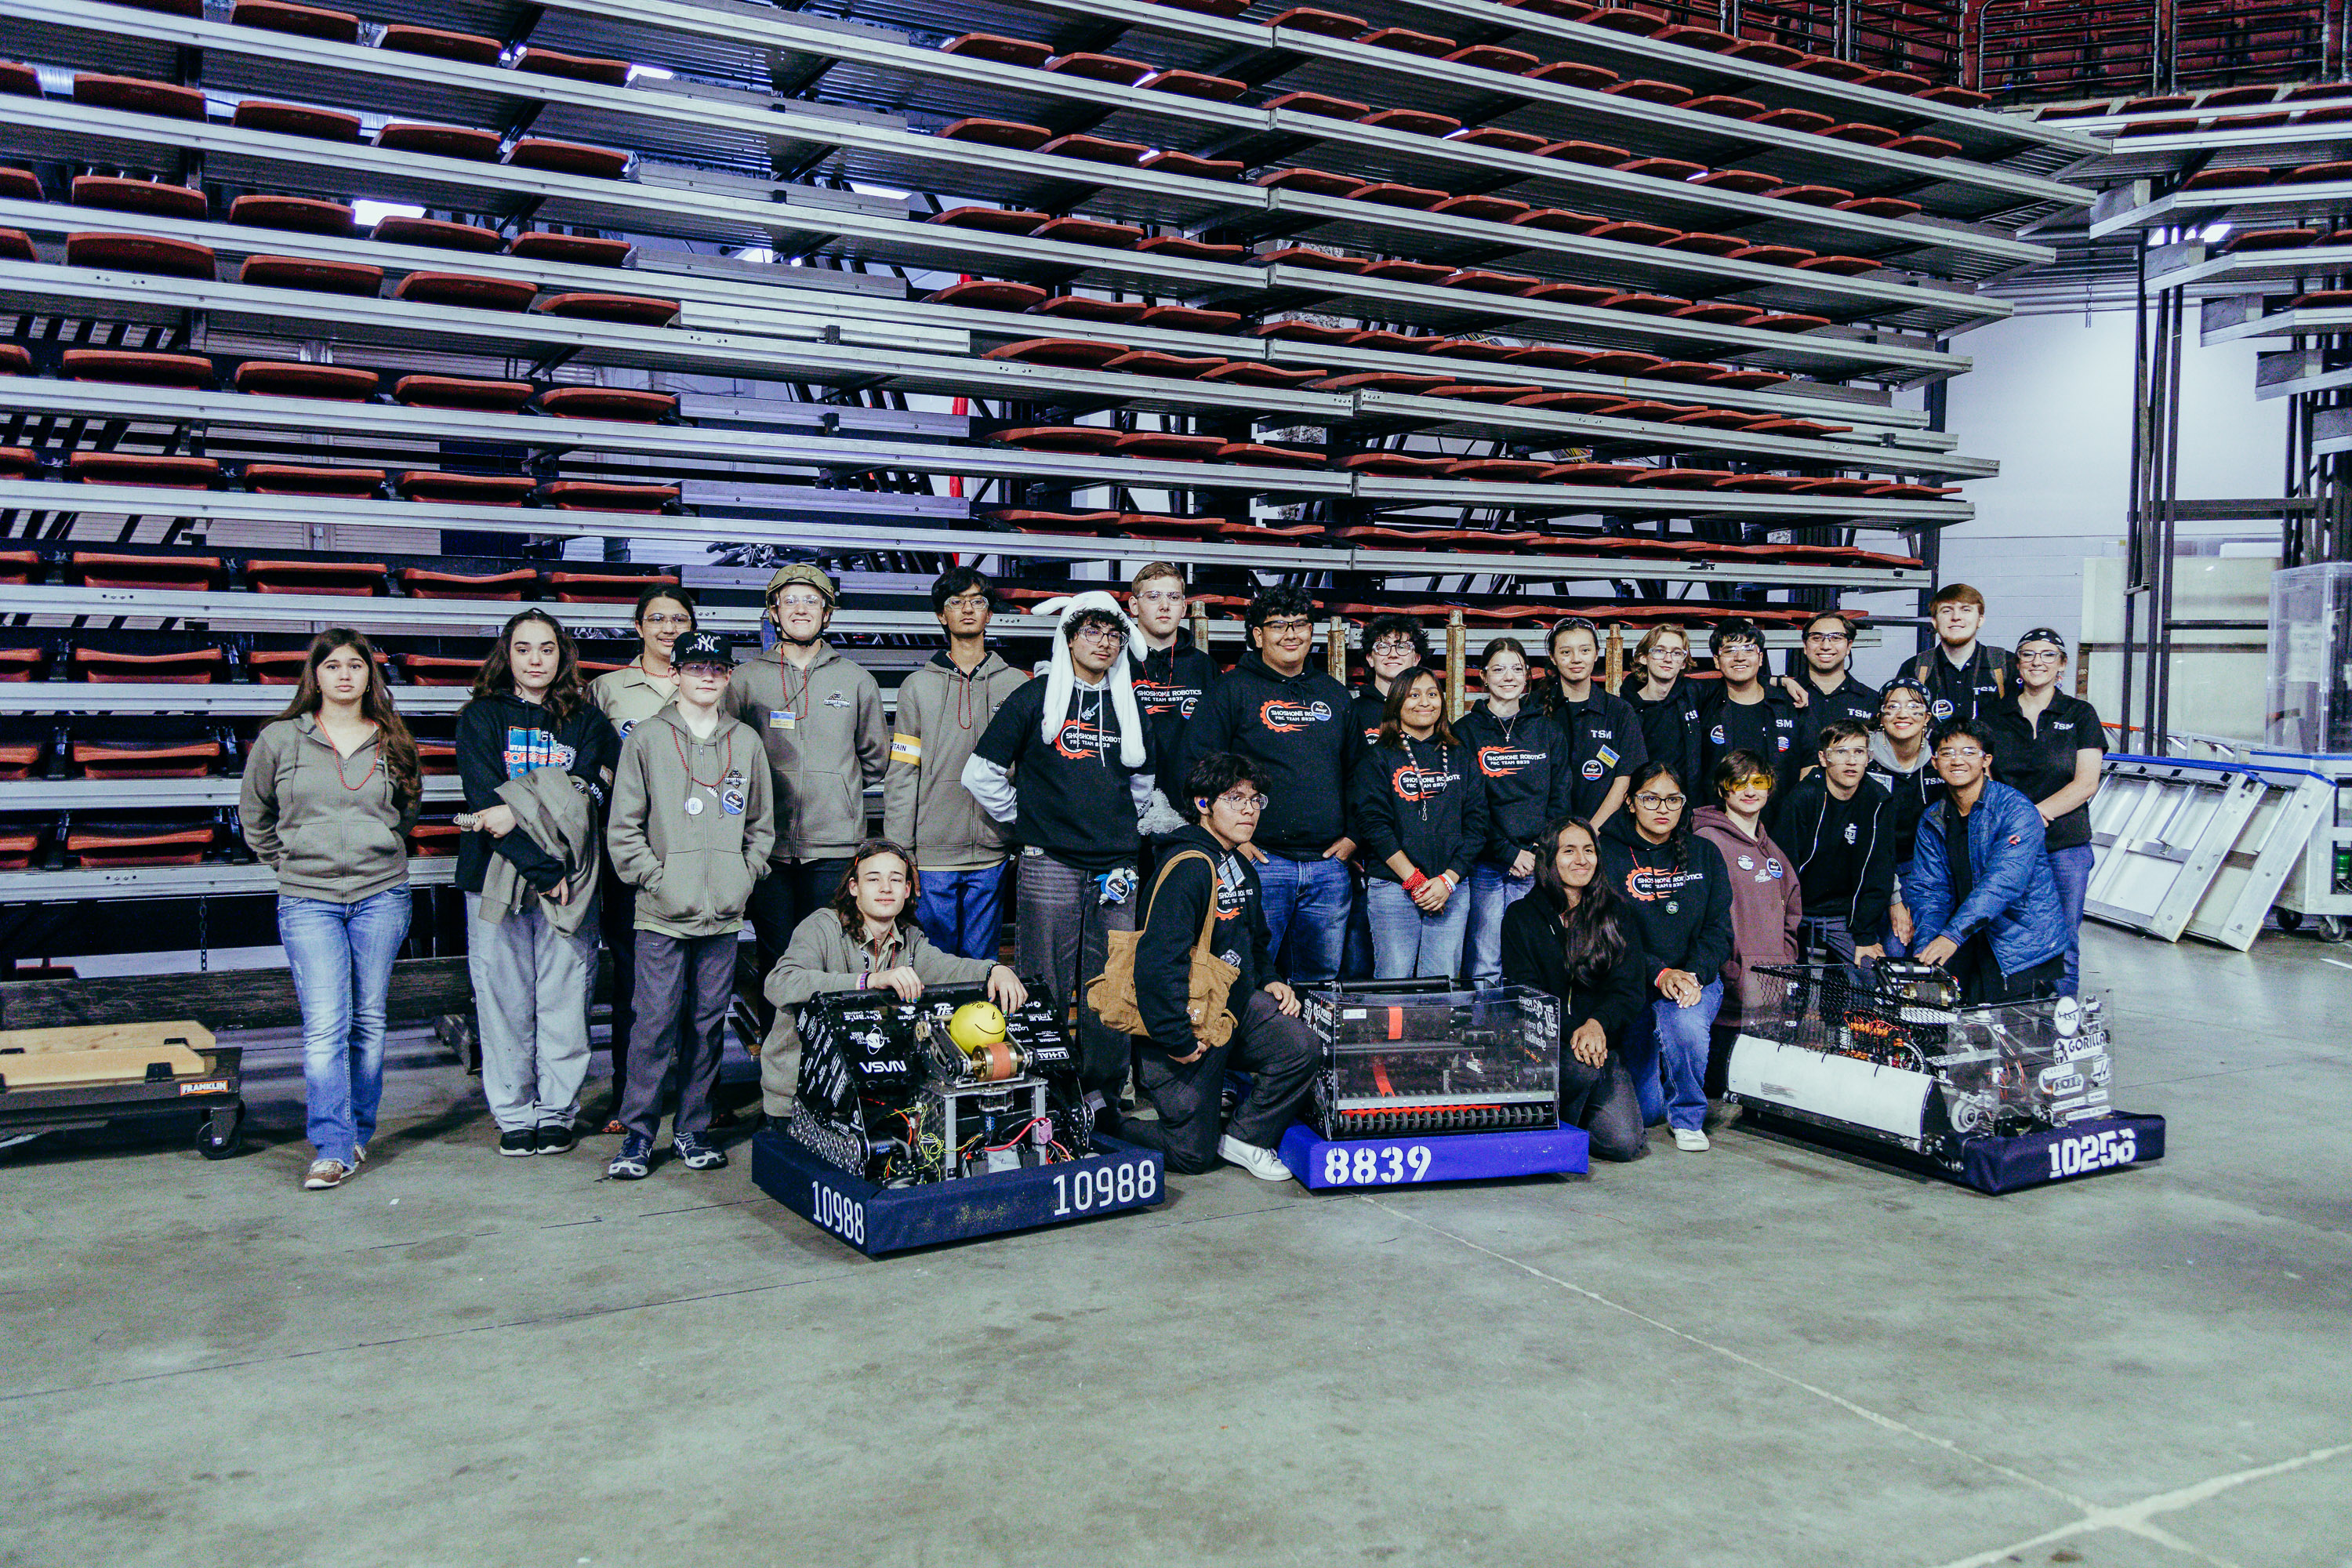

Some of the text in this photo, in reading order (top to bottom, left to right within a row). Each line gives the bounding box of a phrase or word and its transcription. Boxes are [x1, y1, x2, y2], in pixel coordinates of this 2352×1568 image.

[698, 635, 715, 652] NY
[1847, 708, 1872, 720] TSM
[891, 743, 907, 752] TAIN
[2068, 1033, 2106, 1053] GORILLA
[858, 1060, 907, 1073] NASA
[182, 1081, 227, 1094] FRANKLIN
[2048, 1127, 2136, 1178] 10256
[1324, 1145, 1432, 1185] 8839
[1053, 1160, 1156, 1216] 10988
[812, 1180, 865, 1245] 10988
